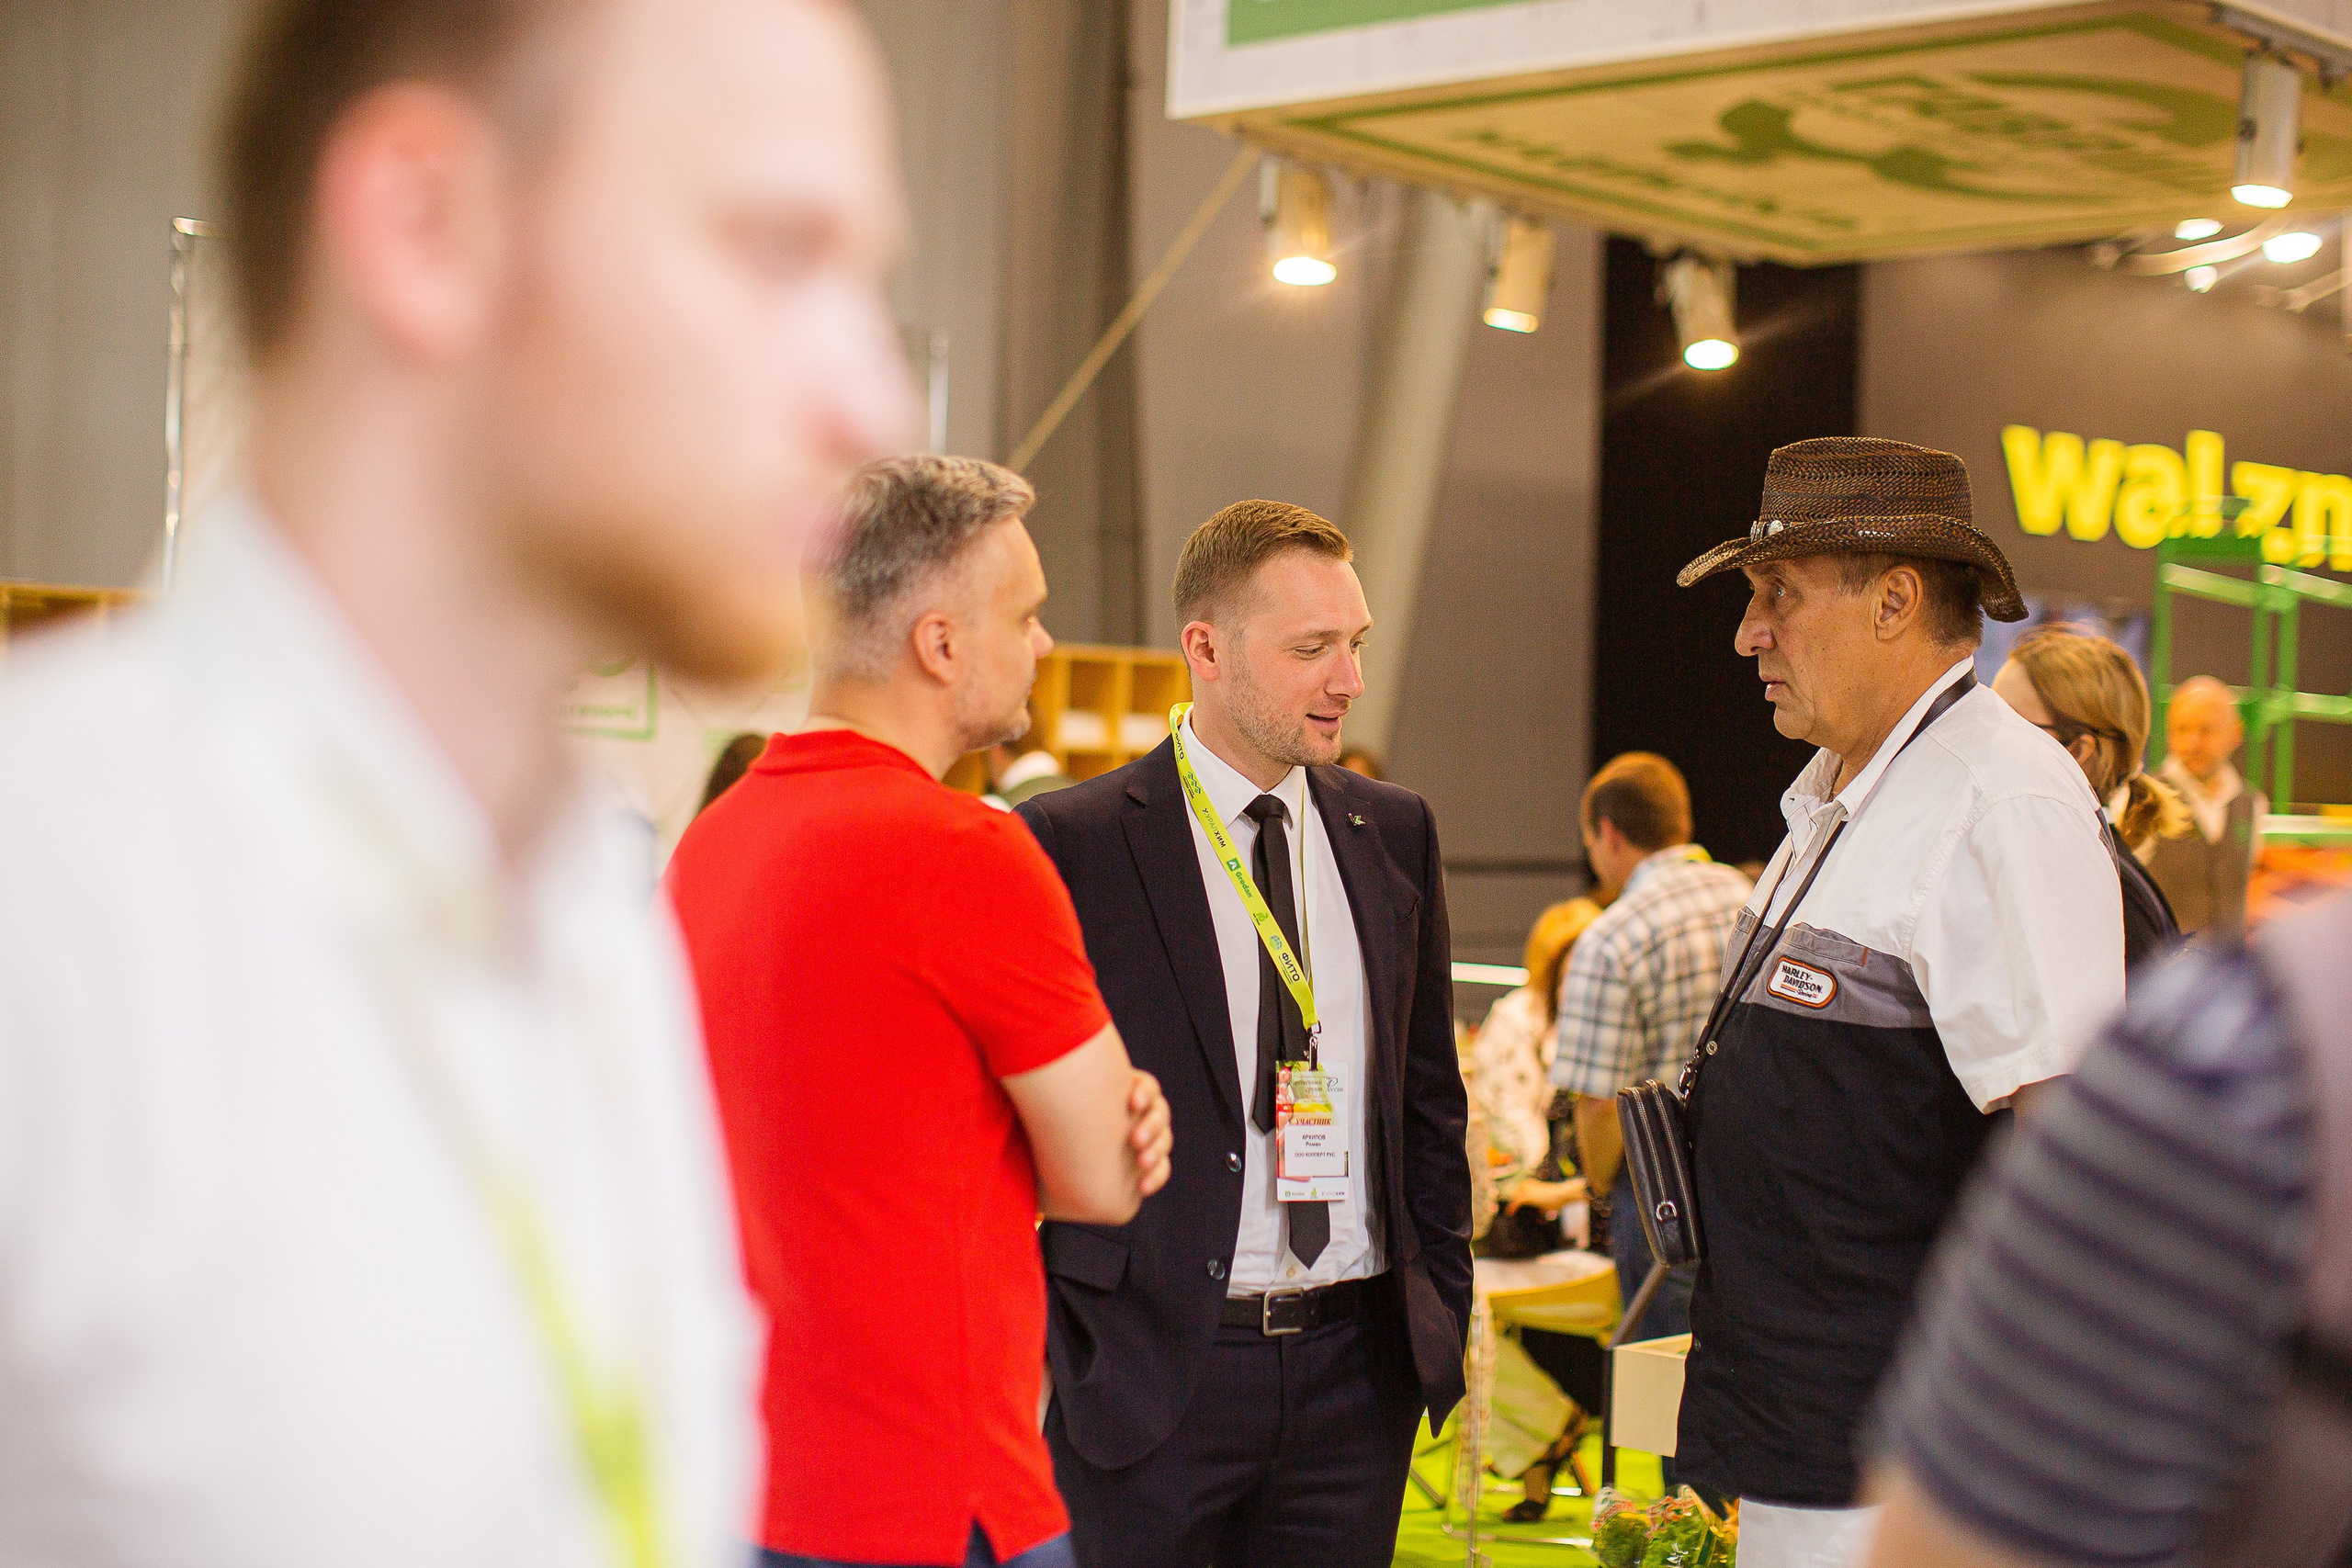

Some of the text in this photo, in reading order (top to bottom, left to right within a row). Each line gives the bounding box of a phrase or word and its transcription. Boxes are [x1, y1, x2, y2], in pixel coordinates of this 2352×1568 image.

[1236, 872, 1253, 898] Grodan
[1282, 952, 1300, 981] ФИТО
[1781, 964, 1813, 981] HARLEY-
[1782, 975, 1823, 993] DAVIDSON
[1295, 1118, 1332, 1126] УЧАСТНИК
